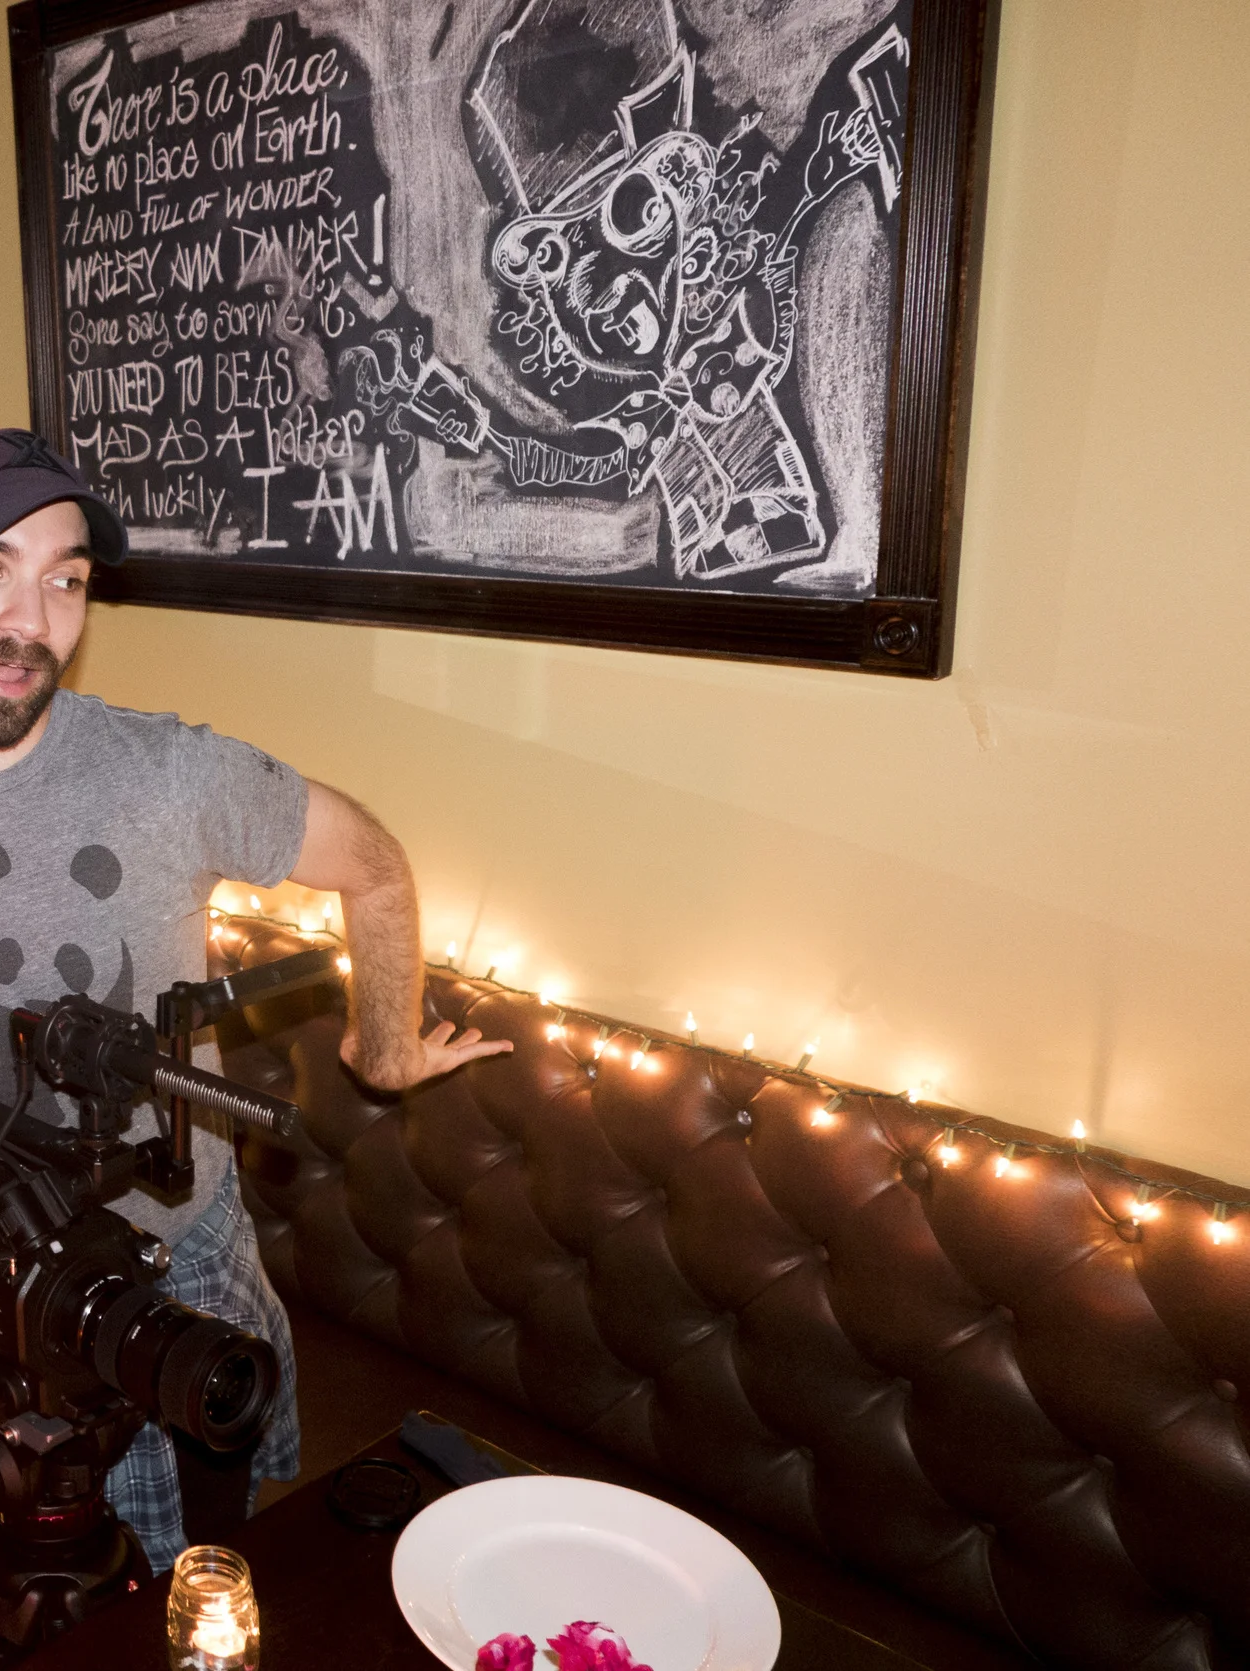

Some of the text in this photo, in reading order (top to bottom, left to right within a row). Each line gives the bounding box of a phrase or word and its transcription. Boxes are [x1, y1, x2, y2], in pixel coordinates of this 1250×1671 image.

[68, 49, 162, 156] There
[166, 66, 200, 124] is
[205, 71, 234, 119] a
[105, 153, 128, 193] no
[134, 136, 200, 212] place
[212, 122, 247, 171] on
[254, 92, 357, 163] Earth.
[63, 207, 81, 246] A
[81, 203, 134, 246] LAND
[188, 191, 220, 223] OF
[68, 310, 123, 365] Some
[127, 310, 174, 358] say
[174, 302, 209, 340] to
[67, 347, 294, 421] YOU NEED TO BE AS
[70, 420, 151, 479] MAD
[156, 418, 210, 470] AS
[215, 416, 255, 464] A
[243, 466, 289, 549] I
[293, 442, 398, 560] AM
